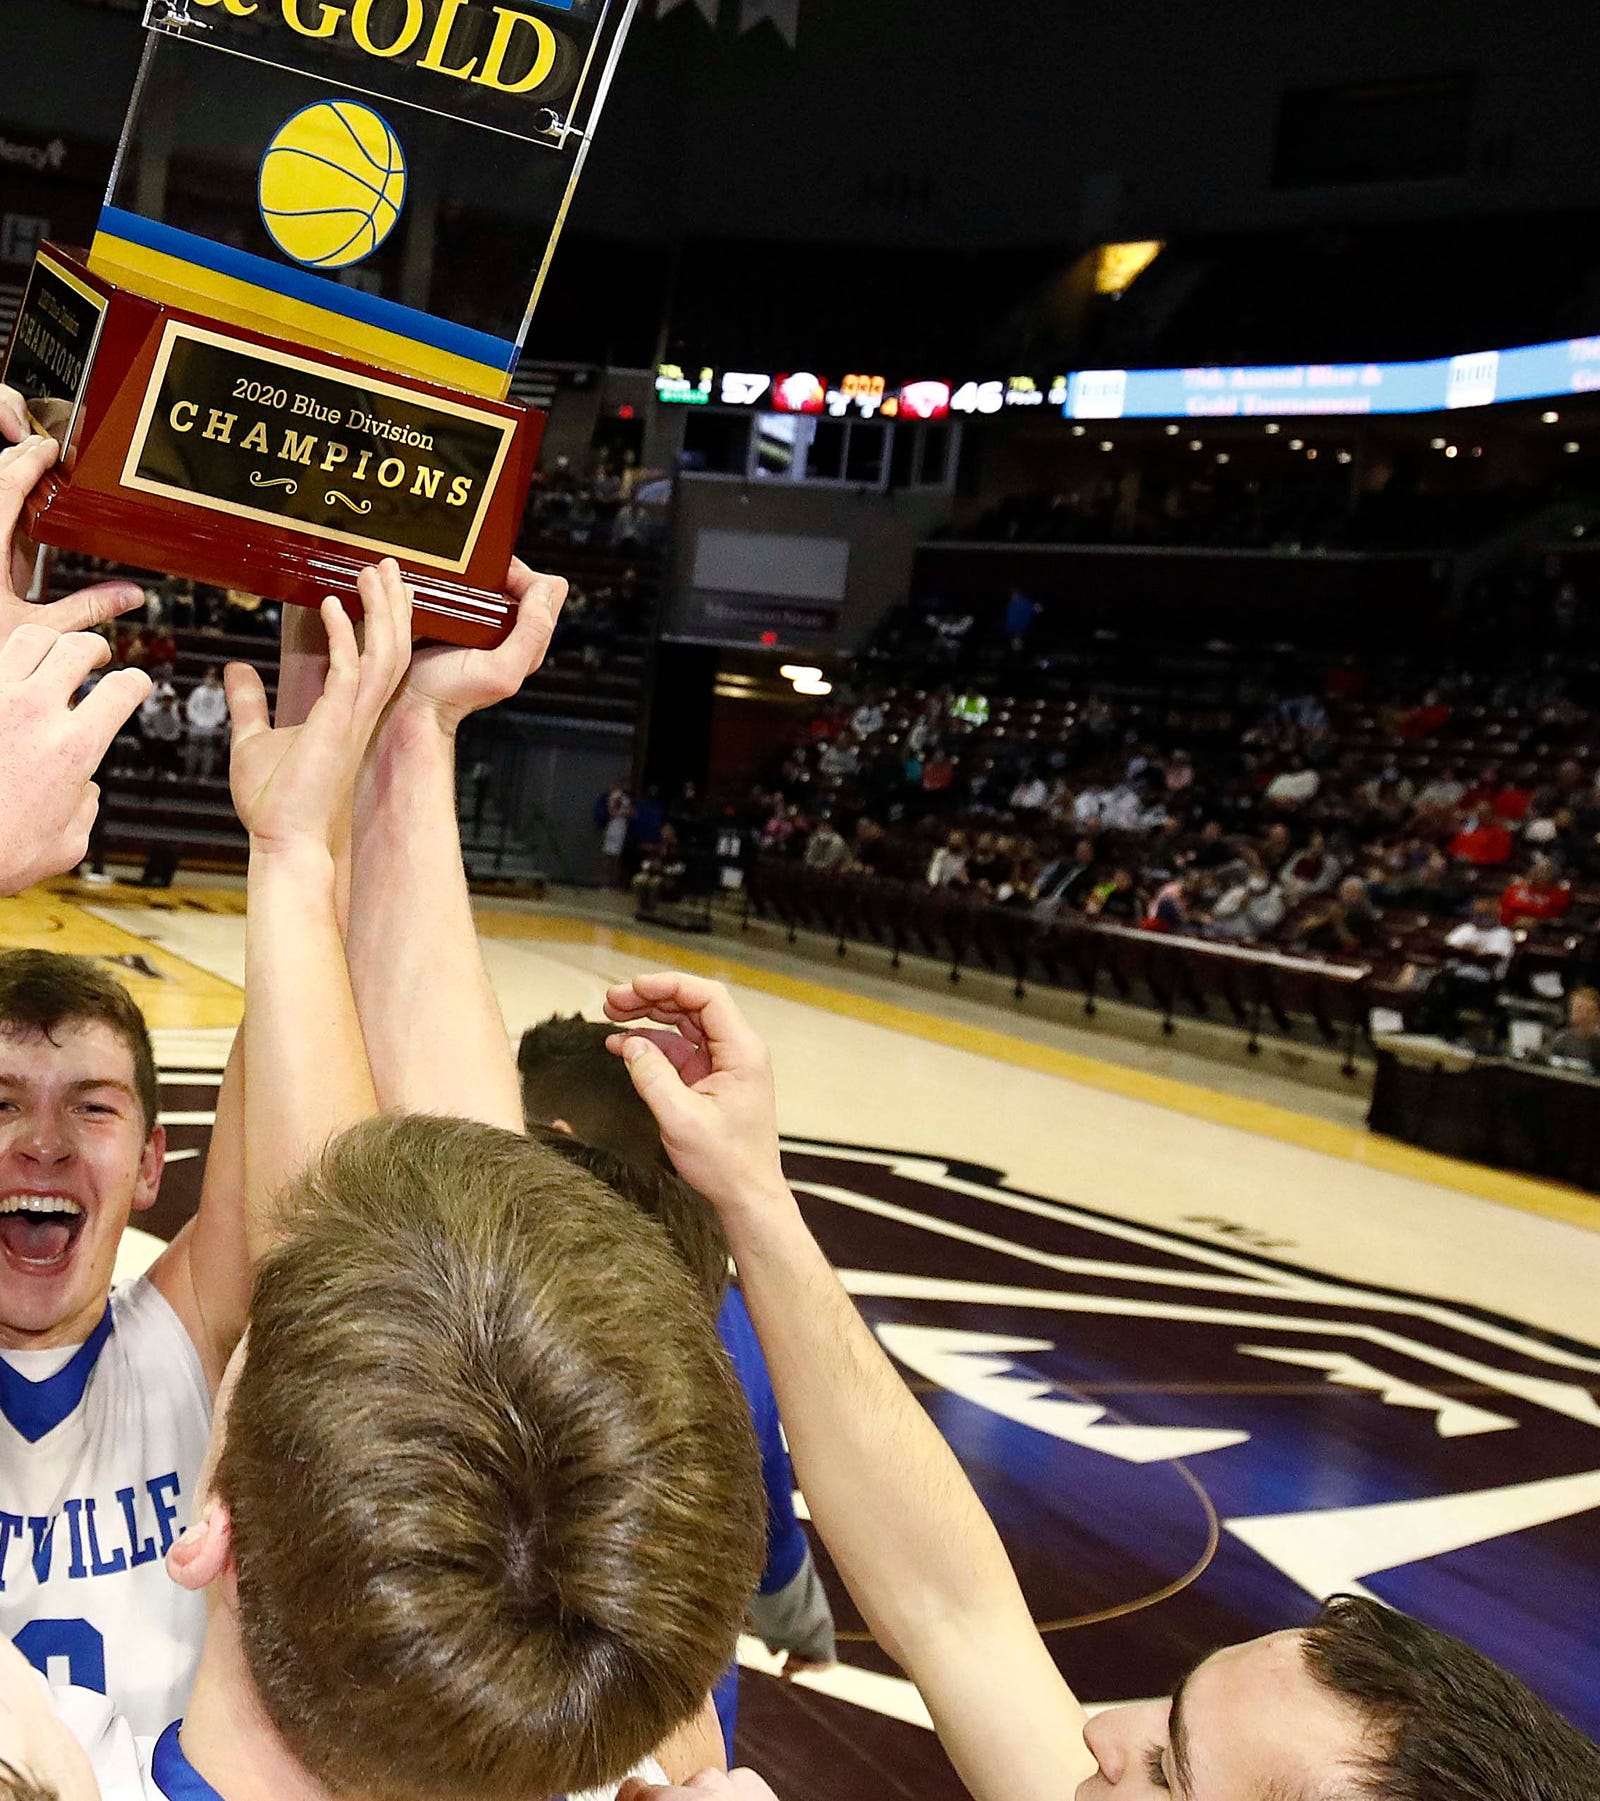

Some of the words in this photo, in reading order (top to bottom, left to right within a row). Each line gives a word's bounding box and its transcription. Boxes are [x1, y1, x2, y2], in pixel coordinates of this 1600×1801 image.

[281, 0, 557, 94] GOLD
[19, 313, 82, 391] CHAMPIONS
[721, 372, 771, 404] 57
[232, 378, 288, 409] 2020
[290, 393, 342, 424] Blue
[345, 408, 435, 451] Division
[950, 380, 1004, 414] 46
[169, 399, 474, 507] CHAMPIONS
